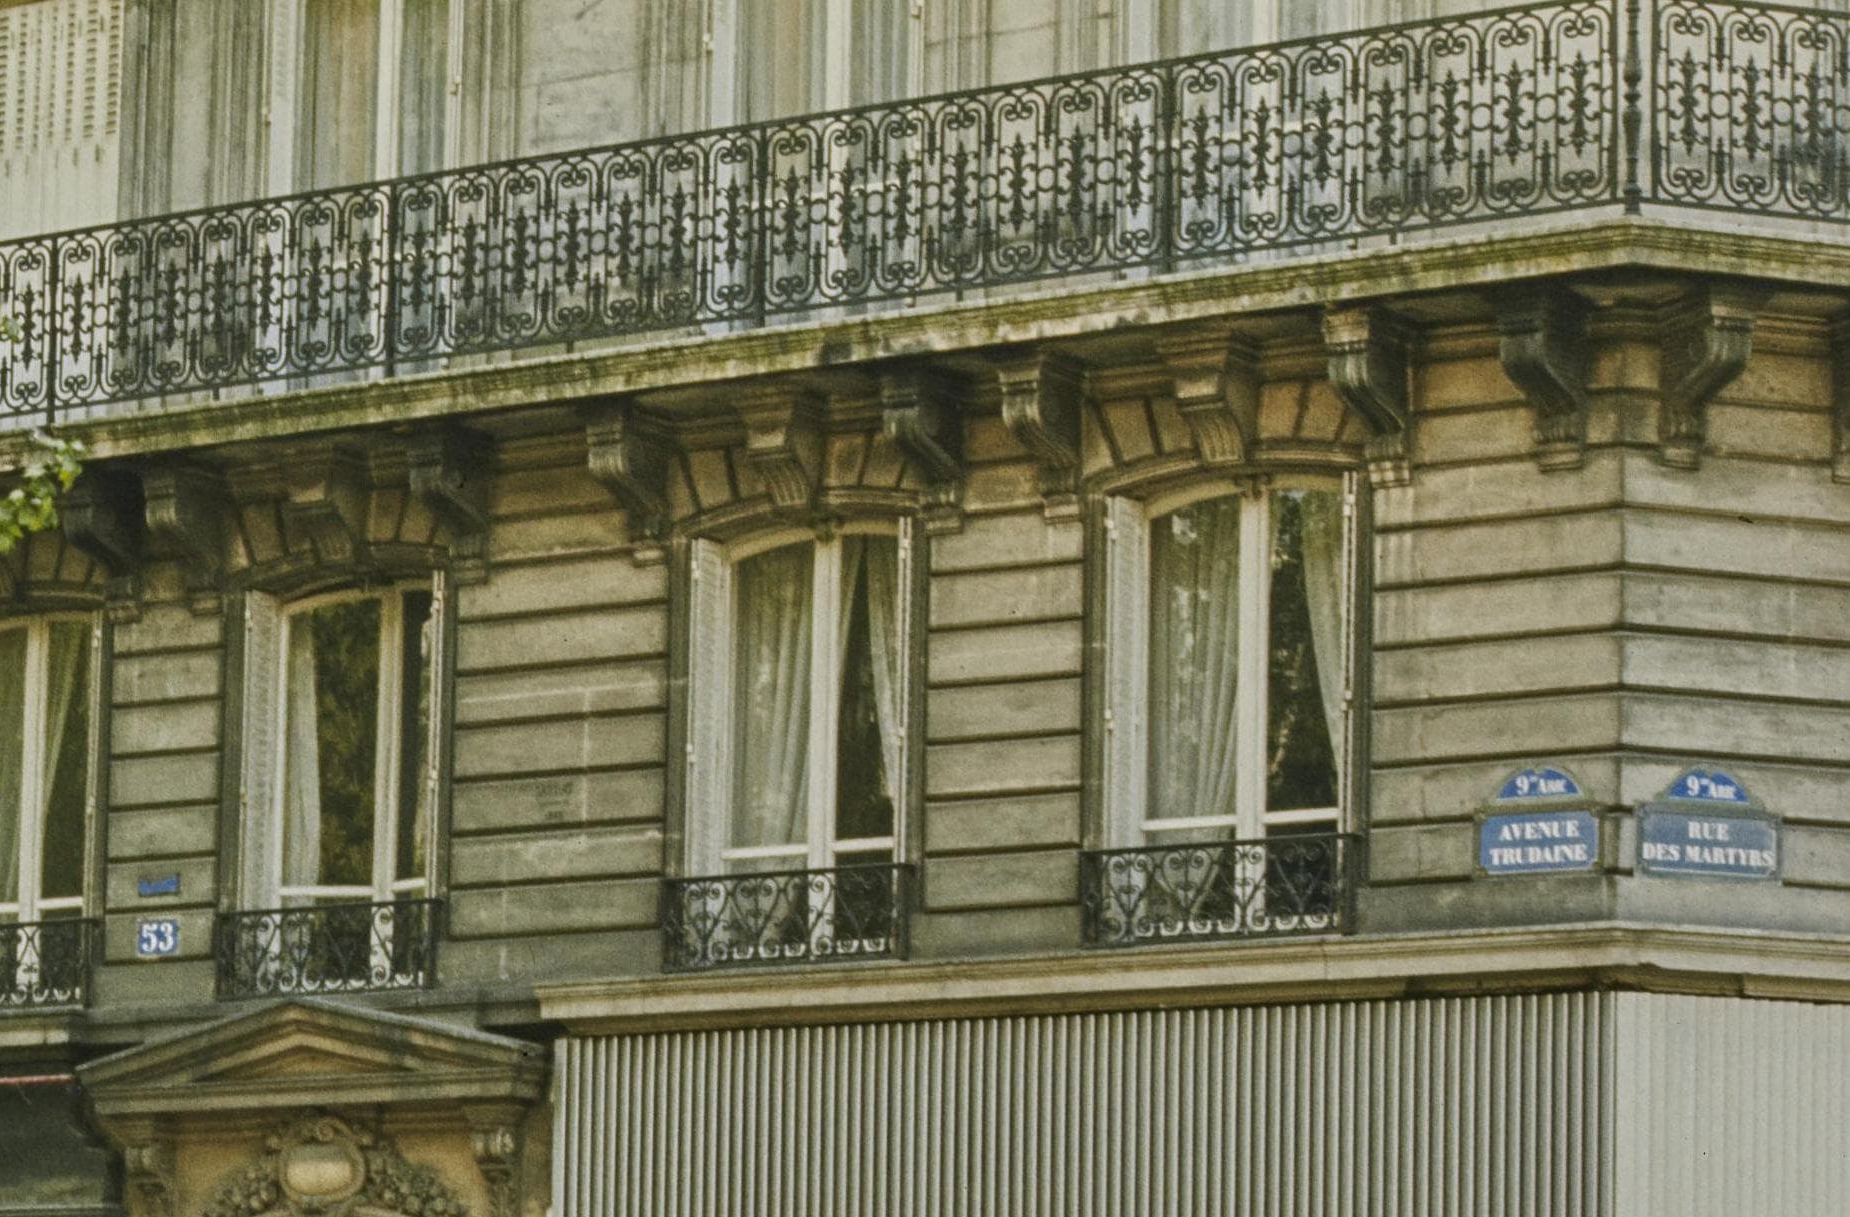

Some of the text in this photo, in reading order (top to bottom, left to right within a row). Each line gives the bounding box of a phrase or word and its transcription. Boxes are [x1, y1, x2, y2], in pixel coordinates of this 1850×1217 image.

[1499, 820, 1580, 841] AVENUE
[1687, 821, 1730, 840] RUE
[1490, 843, 1587, 866] TRUDAINE
[1642, 842, 1776, 866] DES MARTYRS
[141, 922, 174, 952] 53
